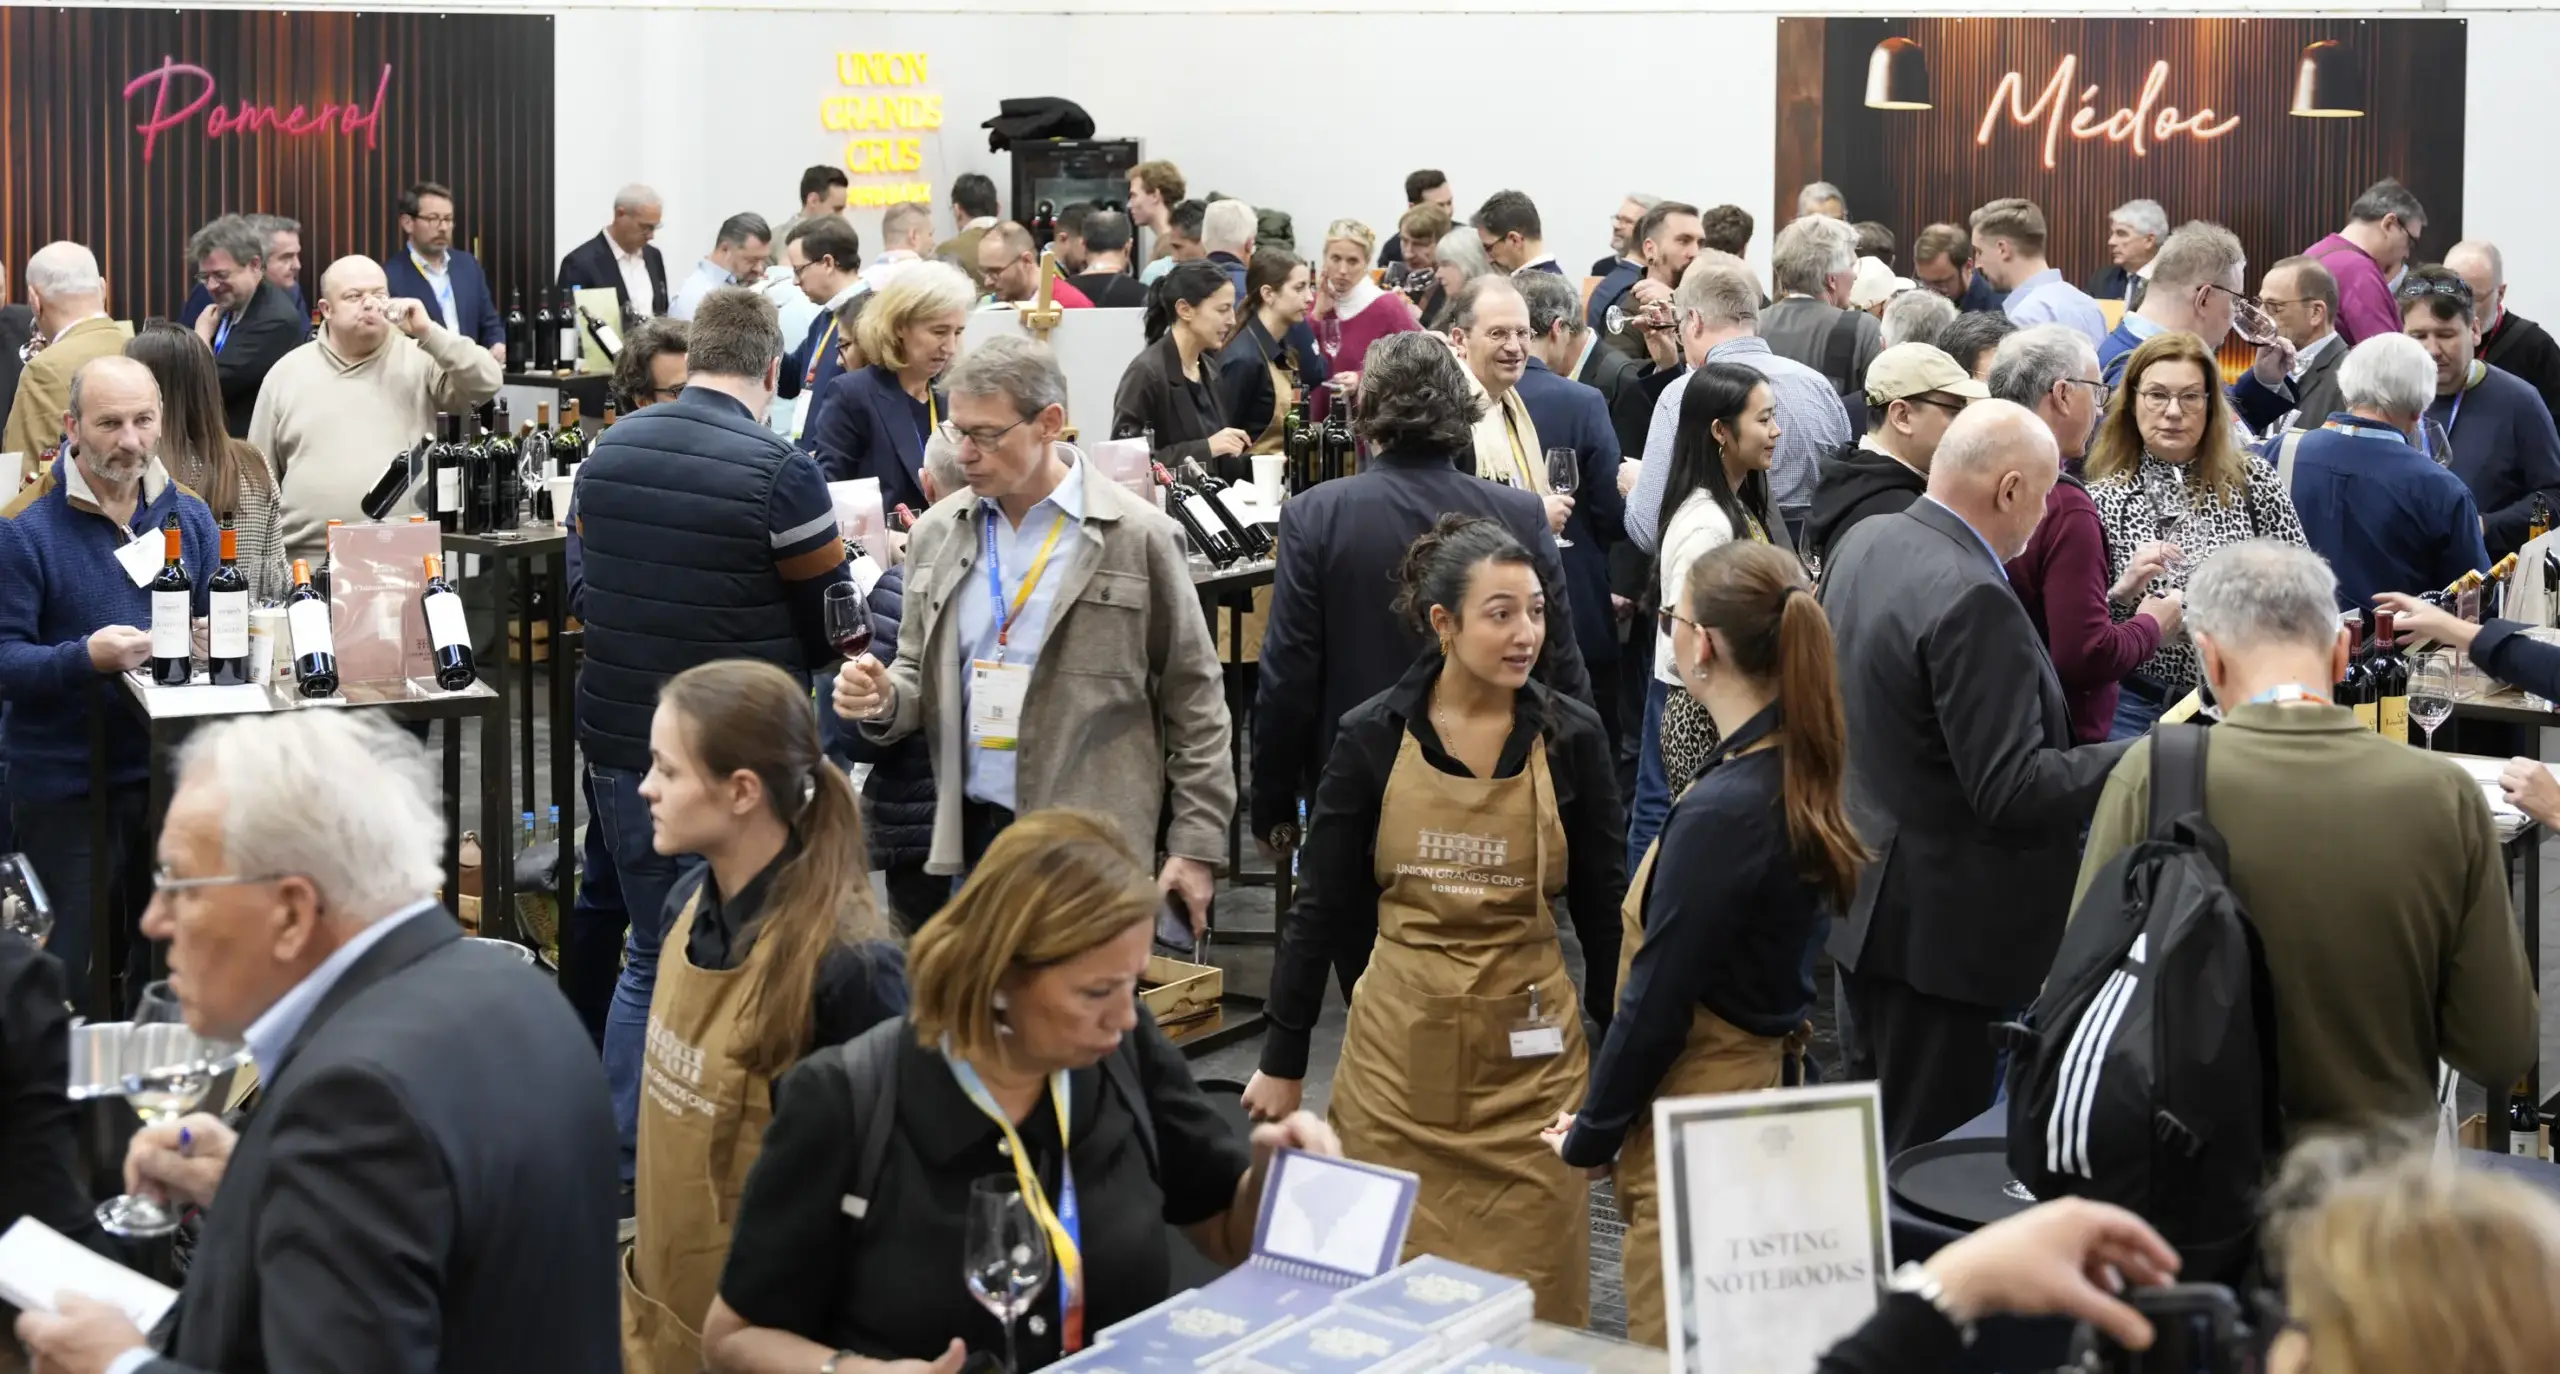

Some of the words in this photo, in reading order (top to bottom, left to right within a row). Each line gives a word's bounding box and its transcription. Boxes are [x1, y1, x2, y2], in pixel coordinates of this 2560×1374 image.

[836, 52, 928, 87] UNION
[123, 54, 392, 165] Pomerol
[820, 95, 944, 132] GRANDS
[1977, 53, 2240, 169] Médoc
[845, 138, 922, 174] CRUS
[1396, 863, 1433, 879] UNION
[1436, 868, 1490, 884] GRANDS
[1491, 874, 1525, 888] CRUS
[1431, 883, 1485, 895] BORDEAUX
[1725, 1227, 1840, 1262] TASTING
[1704, 1258, 1867, 1294] NOTEBOOKS
